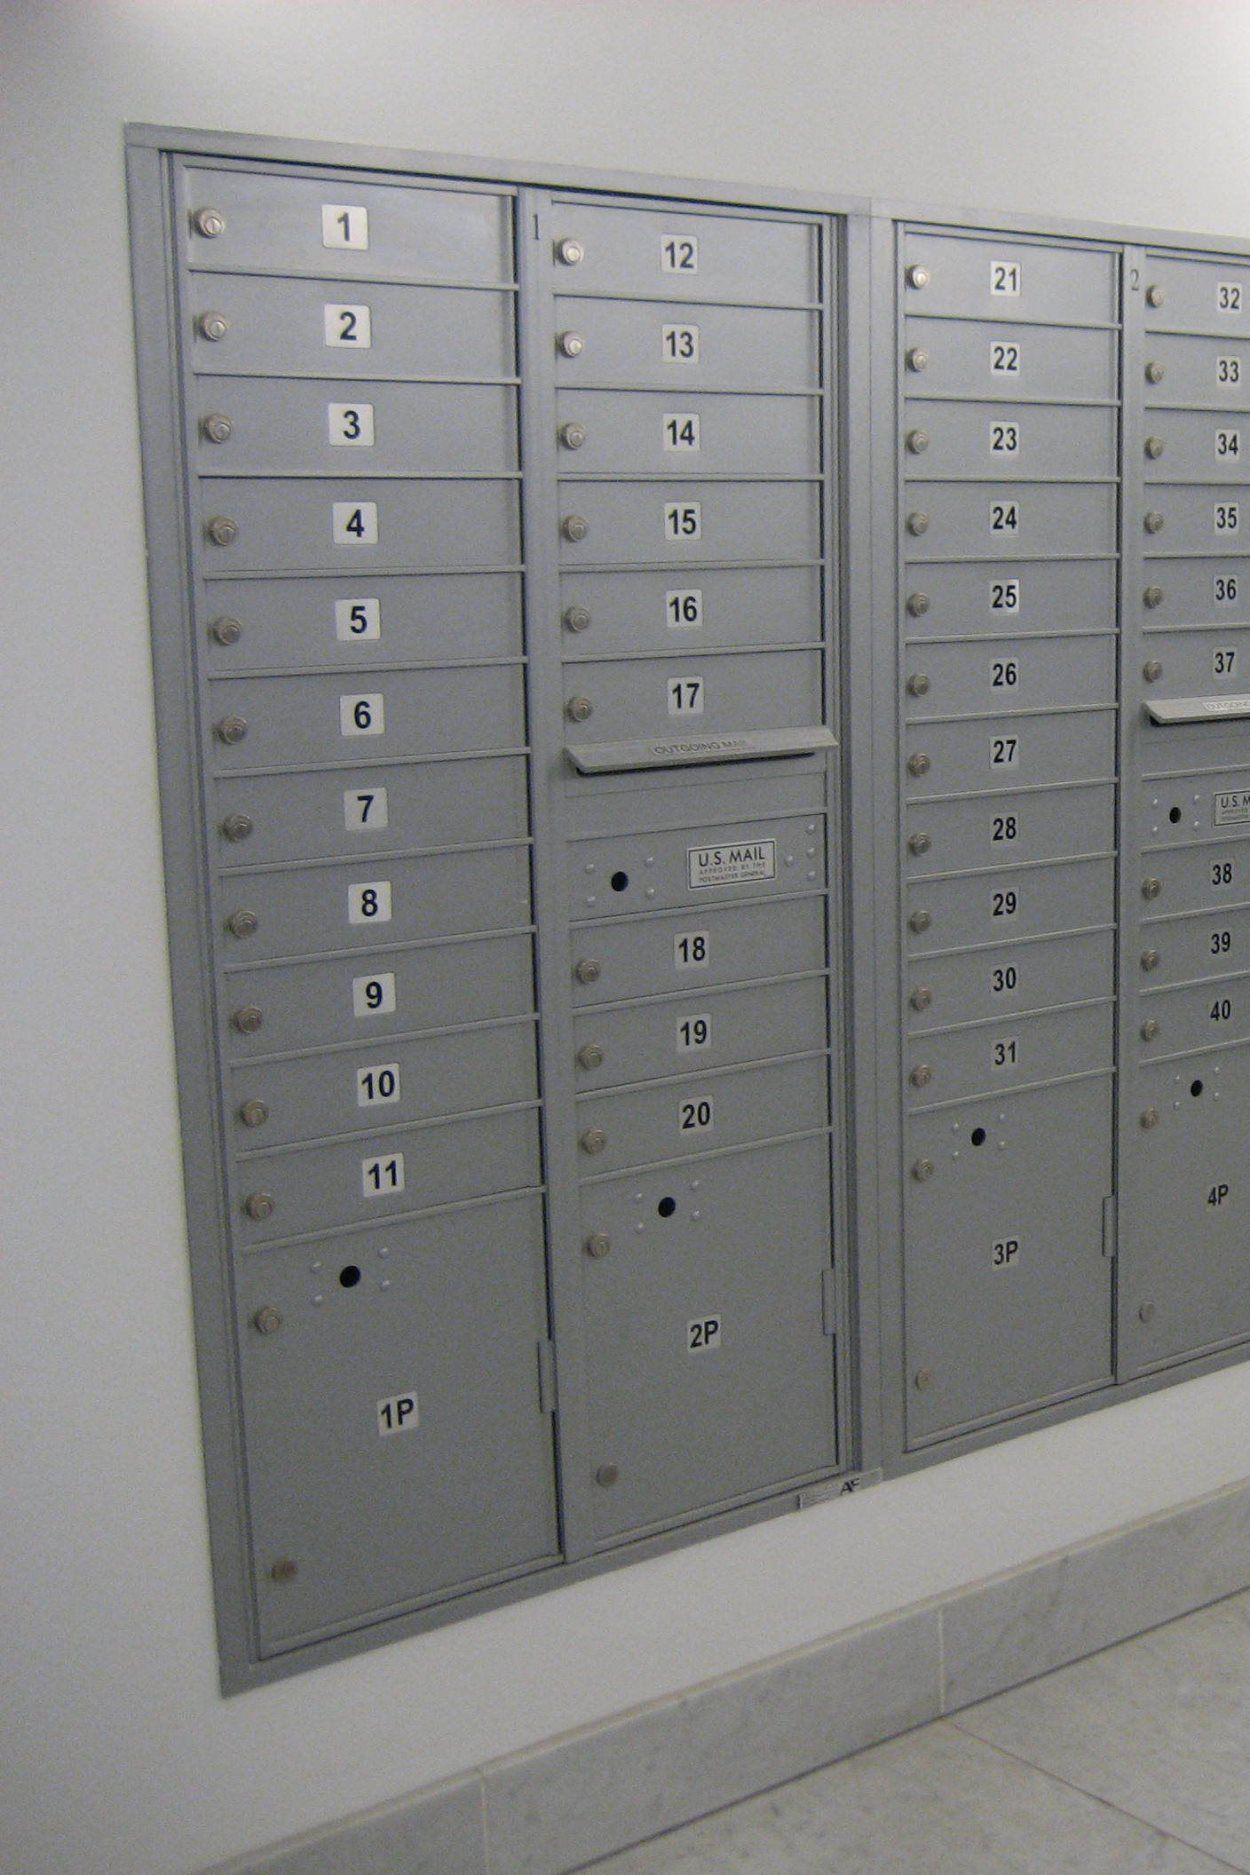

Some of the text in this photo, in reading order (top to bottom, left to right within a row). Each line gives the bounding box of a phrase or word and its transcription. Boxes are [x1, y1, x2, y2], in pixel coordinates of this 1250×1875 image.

[337, 212, 350, 242] 1
[665, 241, 694, 269] 12
[995, 266, 1017, 291] 21
[1130, 268, 1140, 291] 2
[1219, 286, 1240, 310] 32
[339, 311, 357, 341] 2
[666, 331, 694, 358] 13
[993, 346, 1018, 371] 22
[1219, 360, 1239, 383] 33
[343, 410, 361, 440] 3
[667, 419, 695, 446] 14
[992, 426, 1017, 451] 23
[1218, 433, 1239, 455] 34
[346, 509, 365, 538] 4
[668, 509, 697, 535] 15
[992, 506, 1017, 530] 24
[1216, 506, 1237, 529] 35
[992, 584, 1017, 609] 25
[1215, 578, 1237, 601] 36
[350, 605, 367, 634] 5
[670, 596, 698, 622] 16
[992, 662, 1017, 687] 26
[1214, 651, 1235, 674] 37
[672, 682, 700, 709] 17
[354, 700, 371, 729] 6
[654, 742, 721, 755] OUTGOING
[993, 739, 1017, 764] 27
[357, 794, 374, 823] 7
[992, 816, 1017, 841] 28
[698, 846, 766, 867] U.S. MAIL
[1212, 862, 1233, 886] 38
[361, 889, 378, 917] 8
[992, 891, 1017, 917] 29
[678, 936, 706, 963] 18
[1210, 931, 1231, 955] 39
[993, 966, 1017, 992] 30
[365, 981, 383, 1009] 9
[1209, 999, 1232, 1021] 40
[680, 1019, 707, 1046] 19
[994, 1041, 1016, 1066] 31
[362, 1070, 395, 1100] 10
[682, 1101, 711, 1129] 20
[368, 1160, 397, 1189] 11
[1207, 1183, 1229, 1206] 4P
[994, 1240, 1019, 1266] 3P
[690, 1320, 719, 1348] 2P
[381, 1398, 414, 1428] 1P
